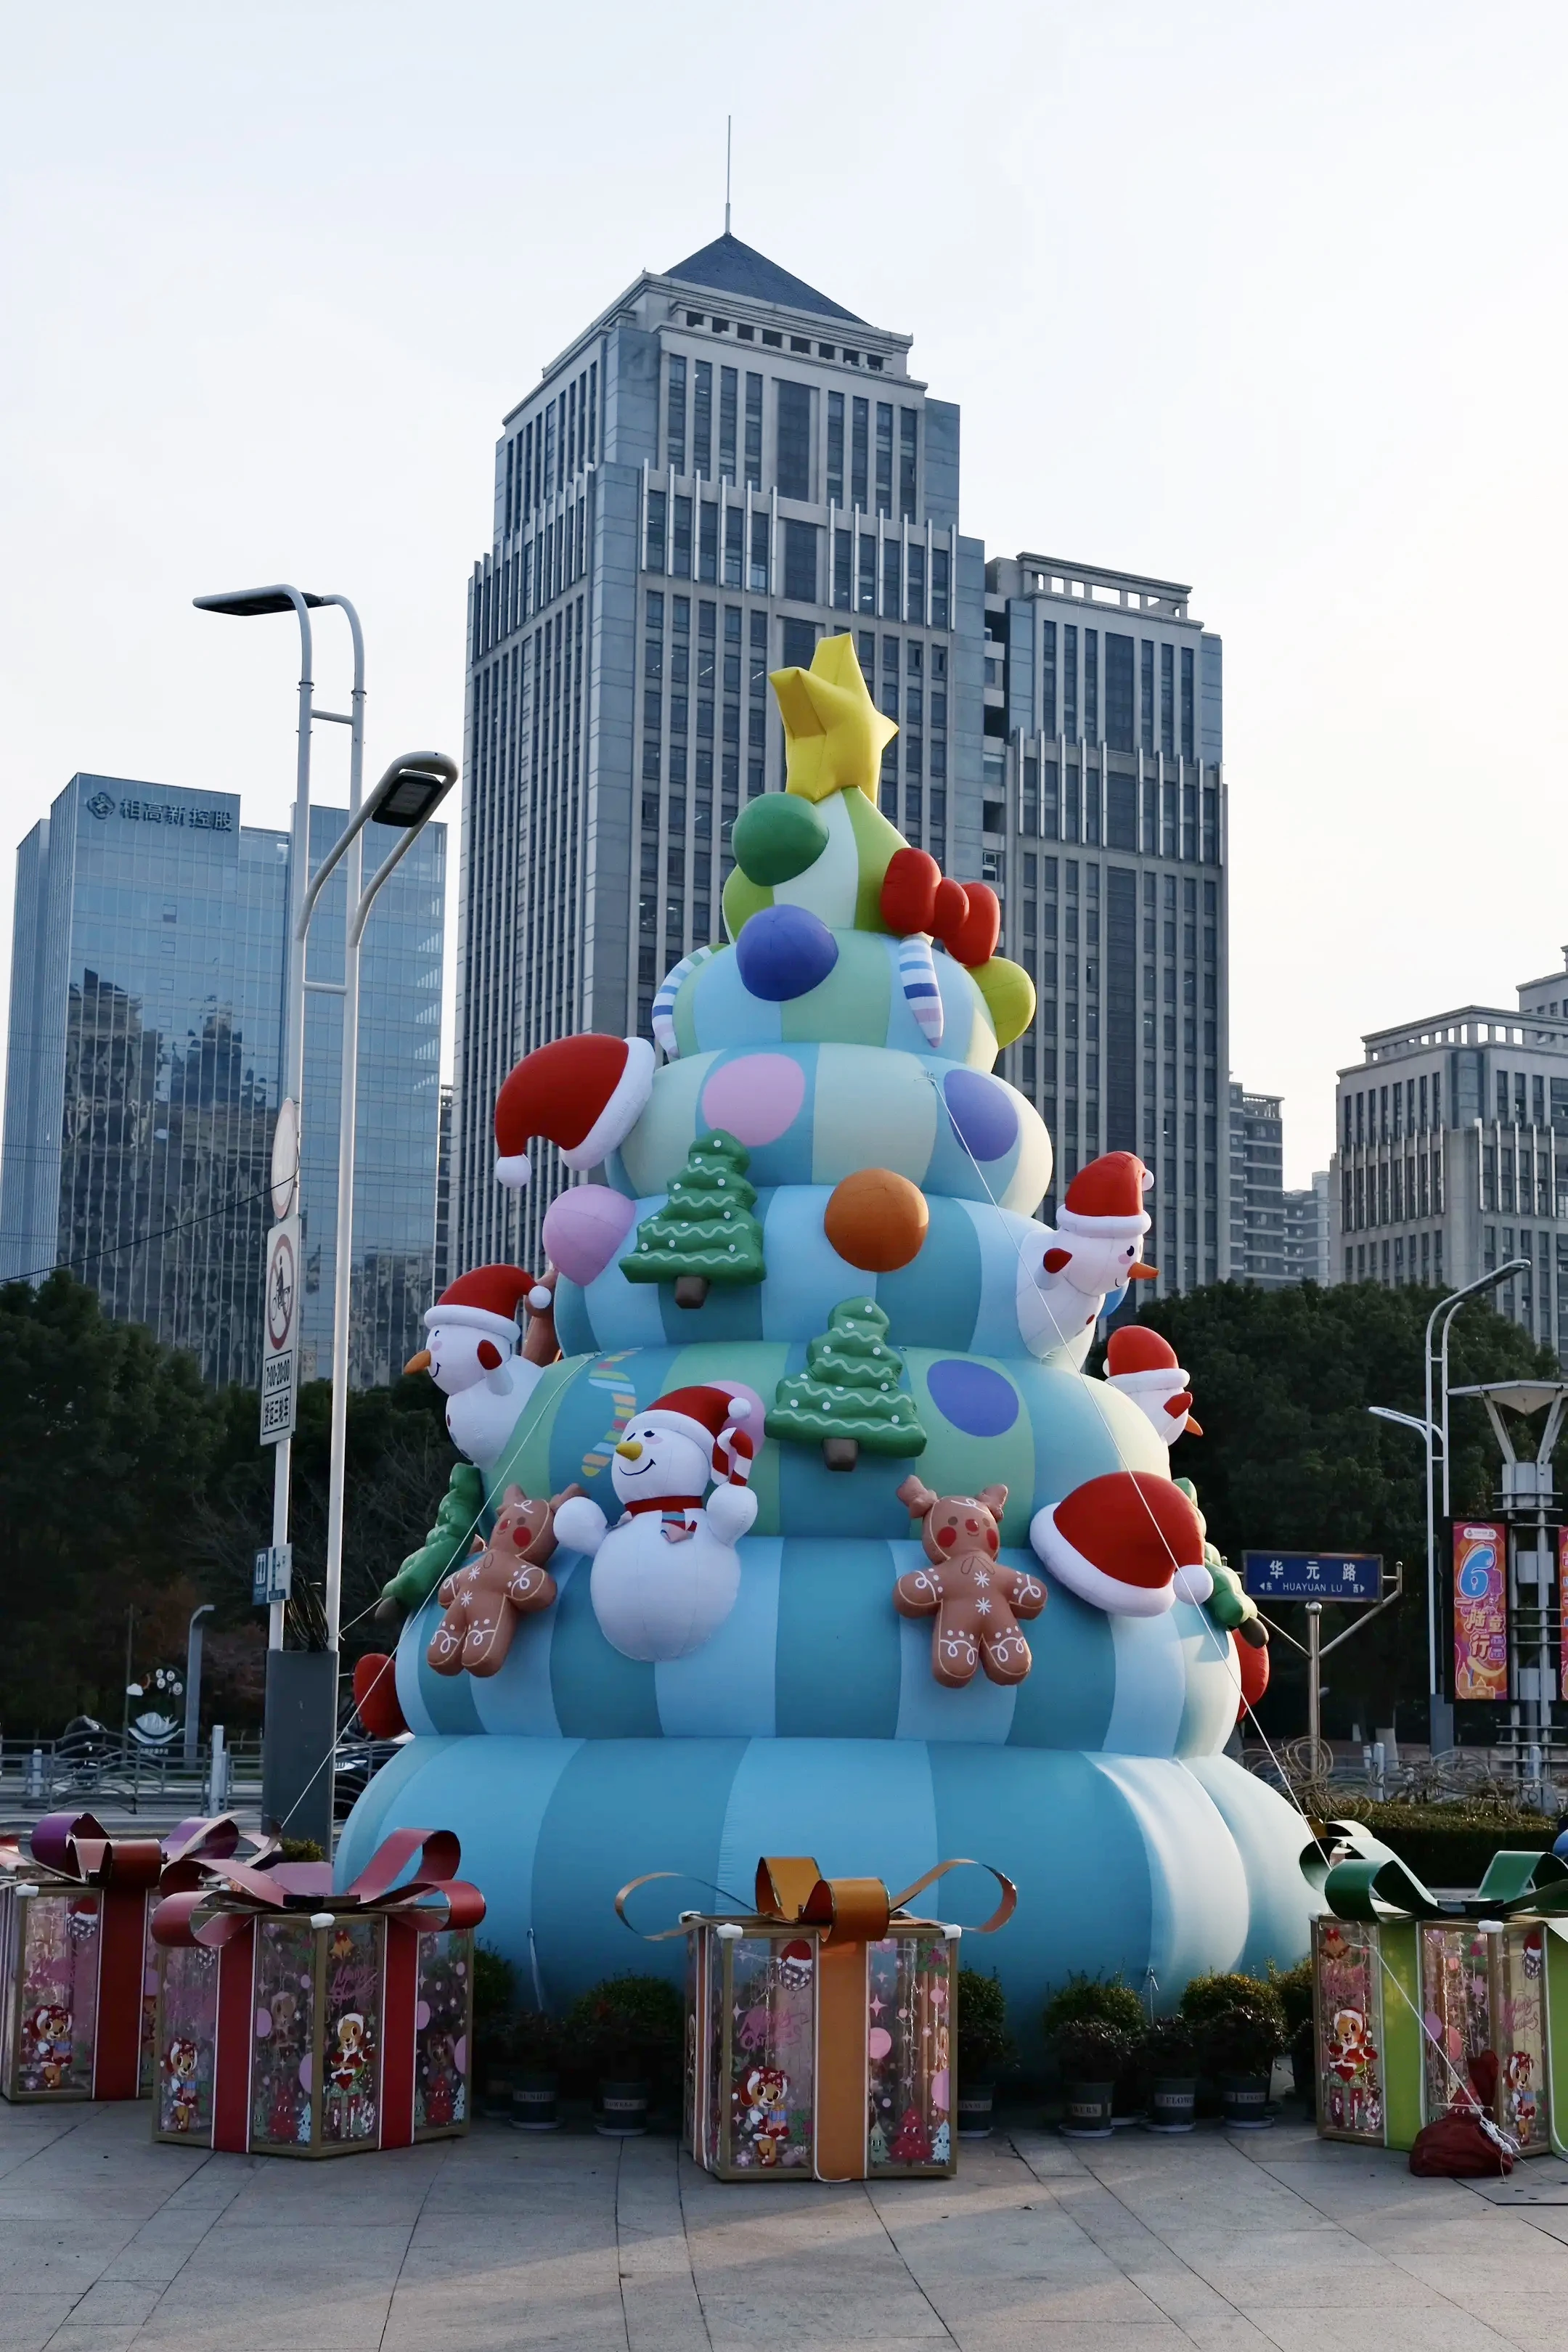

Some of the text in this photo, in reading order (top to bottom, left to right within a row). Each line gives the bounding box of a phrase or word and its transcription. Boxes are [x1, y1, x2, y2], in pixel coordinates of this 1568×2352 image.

[266, 1358, 290, 1389] 7:00-20:00
[264, 1395, 289, 1428] 货运三轮车
[1269, 1560, 1356, 1582] 华元路
[1266, 1581, 1273, 1592] 东
[1283, 1582, 1327, 1592] HUAYUAN
[1331, 1583, 1343, 1593] LU
